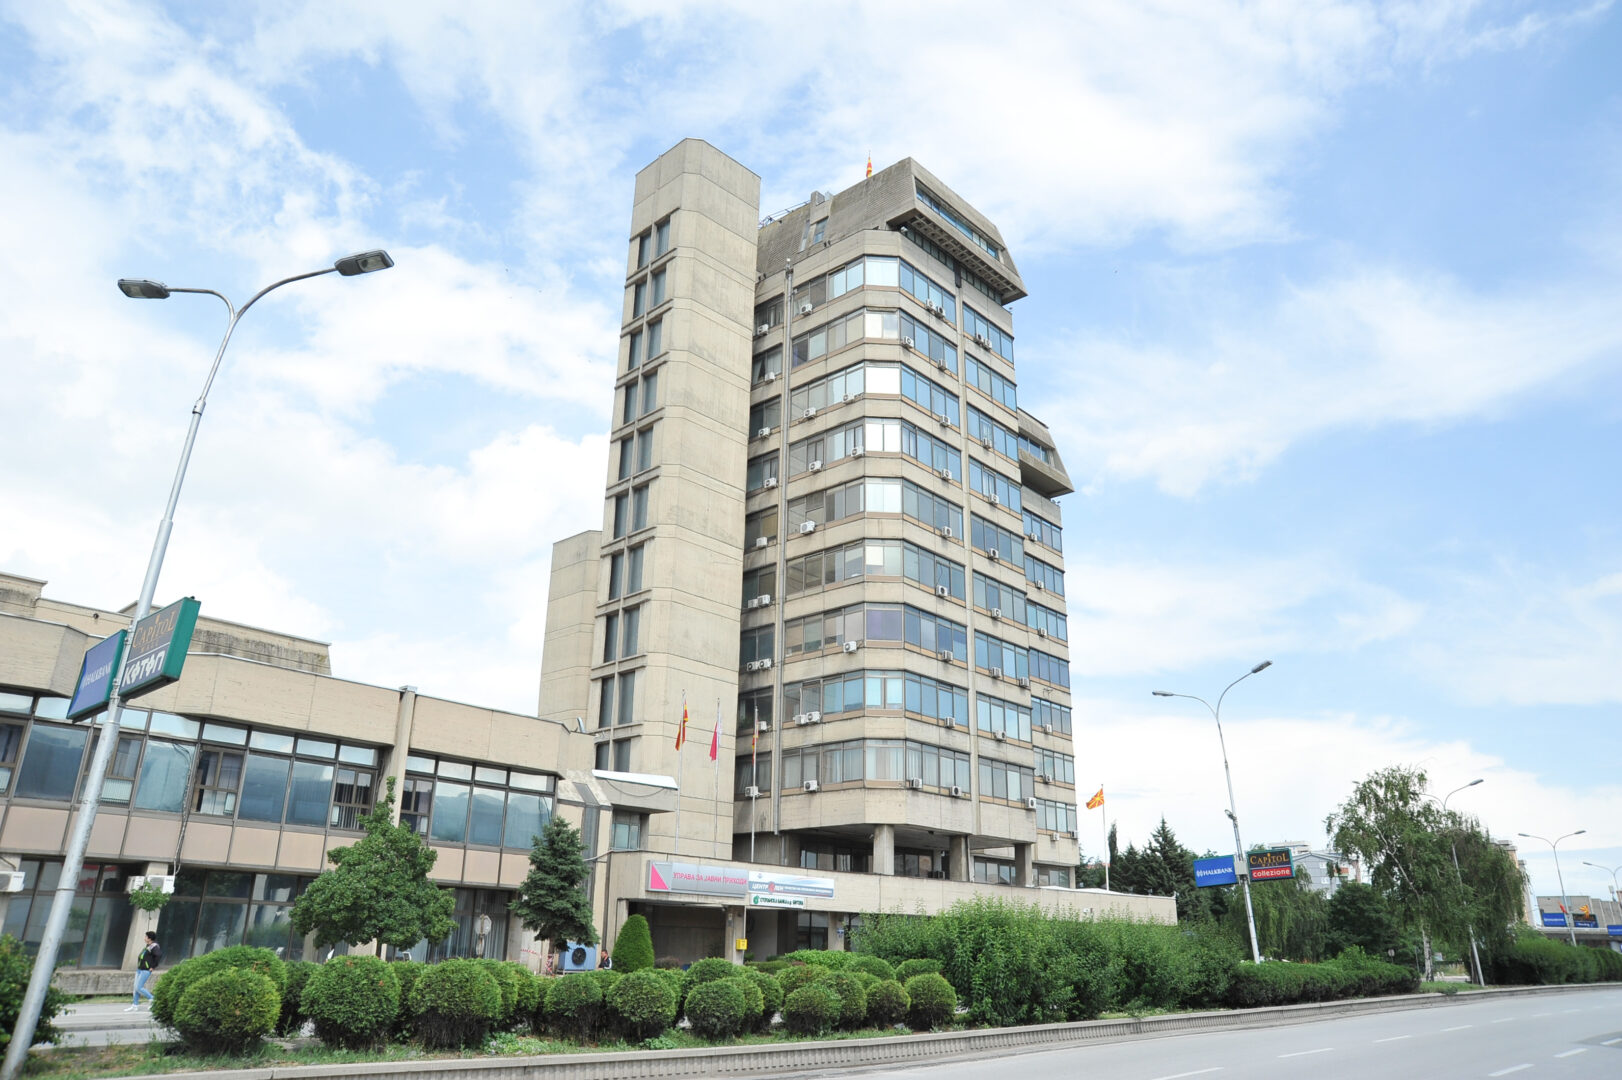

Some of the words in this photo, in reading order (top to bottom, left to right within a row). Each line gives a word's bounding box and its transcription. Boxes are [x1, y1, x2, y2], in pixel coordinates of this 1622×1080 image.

[133, 610, 176, 649] CAPITOL
[1250, 853, 1289, 865] CAPITOL
[1202, 867, 1233, 876] HALKBANK
[1252, 869, 1290, 878] collezione
[672, 872, 695, 881] УПРАВА
[696, 873, 704, 881] ЗА
